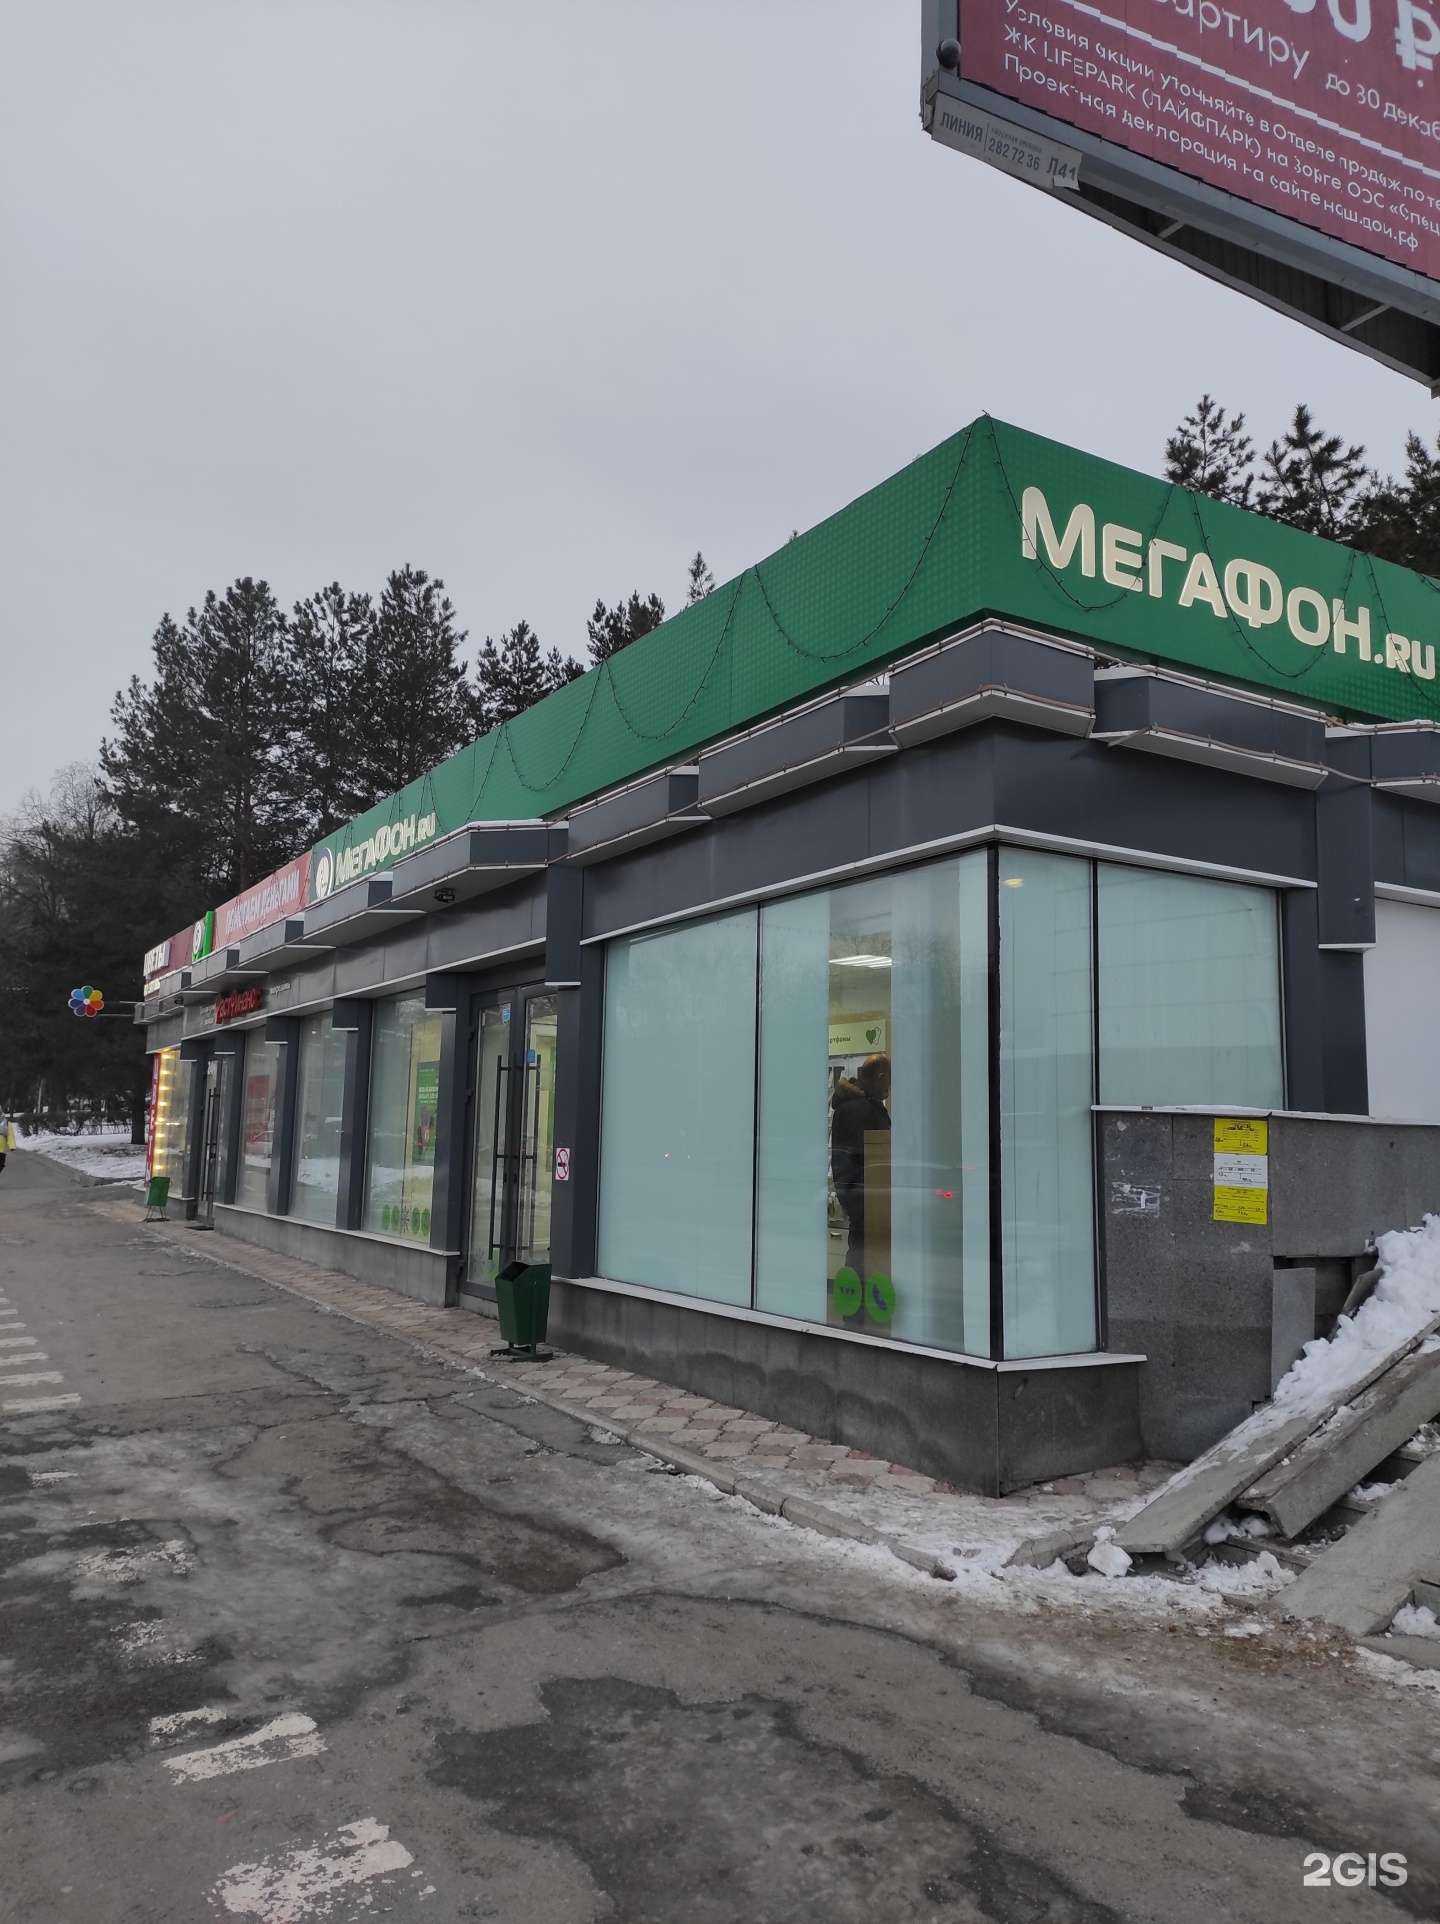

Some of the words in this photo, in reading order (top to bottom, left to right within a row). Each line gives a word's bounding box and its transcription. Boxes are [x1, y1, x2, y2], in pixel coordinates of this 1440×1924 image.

[940, 112, 983, 142] ЛИНИЯ
[1004, 24, 1037, 54] ЖК
[1044, 41, 1136, 99] LIFEPARK
[1142, 88, 1261, 158] (ЛАЙФПАРК)
[1267, 147, 1288, 166] на
[1095, 42, 1154, 81] акции
[1160, 73, 1254, 126] уточняйте
[1260, 120, 1269, 132] в
[1273, 124, 1335, 162] Отделе
[1404, 186, 1425, 202] по
[1325, 73, 1350, 95] до
[1357, 84, 1380, 109] 30
[1243, 162, 1264, 181] на
[1270, 175, 1321, 205] сайте
[1021, 486, 1436, 680] МЕГАФОН.RU
